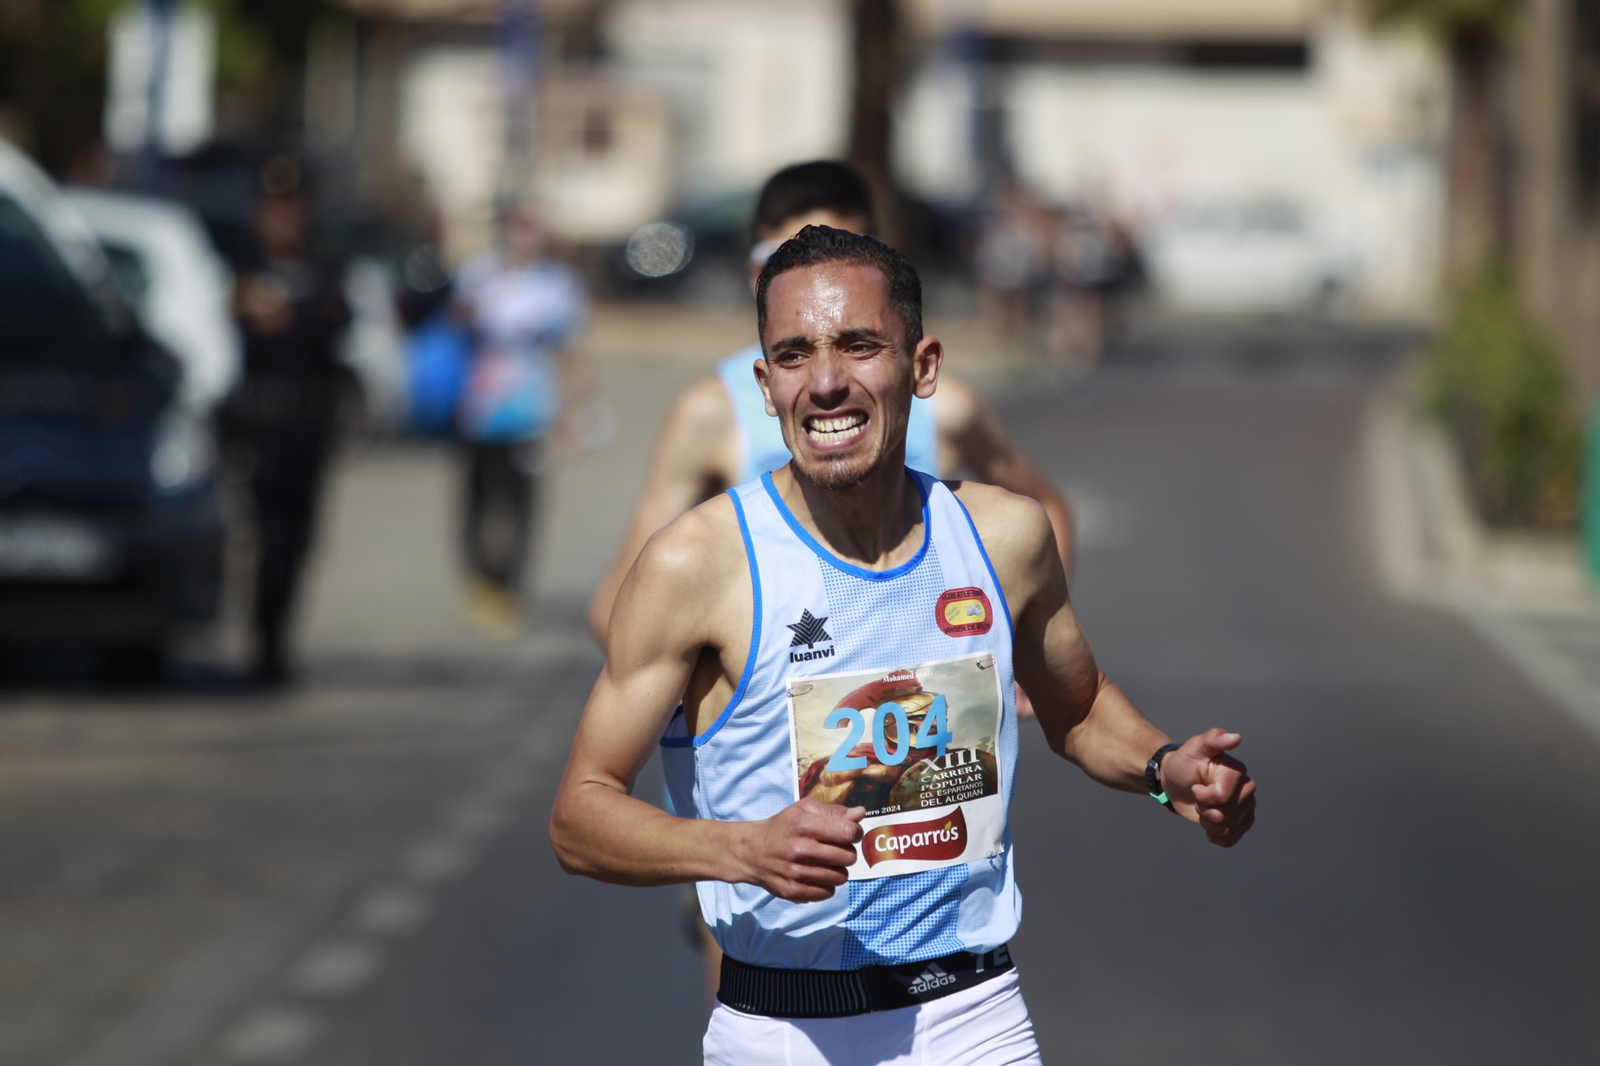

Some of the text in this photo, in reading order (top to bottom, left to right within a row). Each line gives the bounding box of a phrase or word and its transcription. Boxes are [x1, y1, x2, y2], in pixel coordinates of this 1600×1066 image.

[790, 645, 835, 663] luanvi
[882, 671, 914, 683] Mohamed
[824, 694, 953, 773] 204
[920, 747, 980, 775] XIII
[921, 764, 983, 783] CARRERA
[921, 773, 983, 792] POPULAR
[920, 788, 983, 808] DEL ALQUIÁN
[937, 781, 984, 797] ESPARTANOS
[865, 804, 901, 817] nero 2024
[908, 974, 956, 995] adidas
